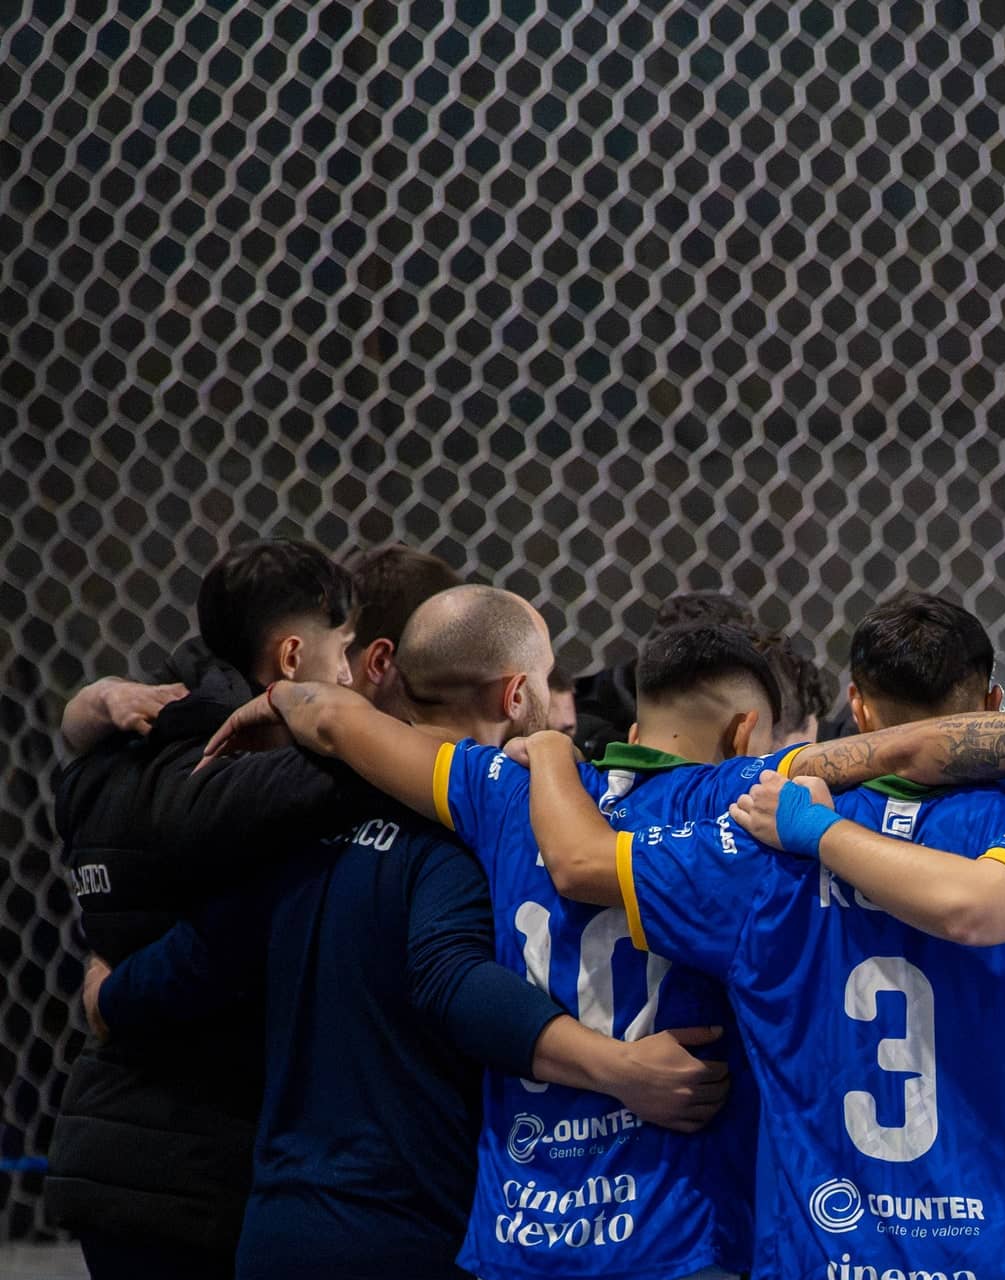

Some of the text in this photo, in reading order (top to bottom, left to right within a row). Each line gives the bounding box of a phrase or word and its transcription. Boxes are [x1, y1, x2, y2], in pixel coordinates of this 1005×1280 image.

[844, 956, 939, 1162] 3
[495, 1210, 635, 1248] devoto
[911, 1226, 928, 1239] de
[932, 1224, 981, 1238] valores
